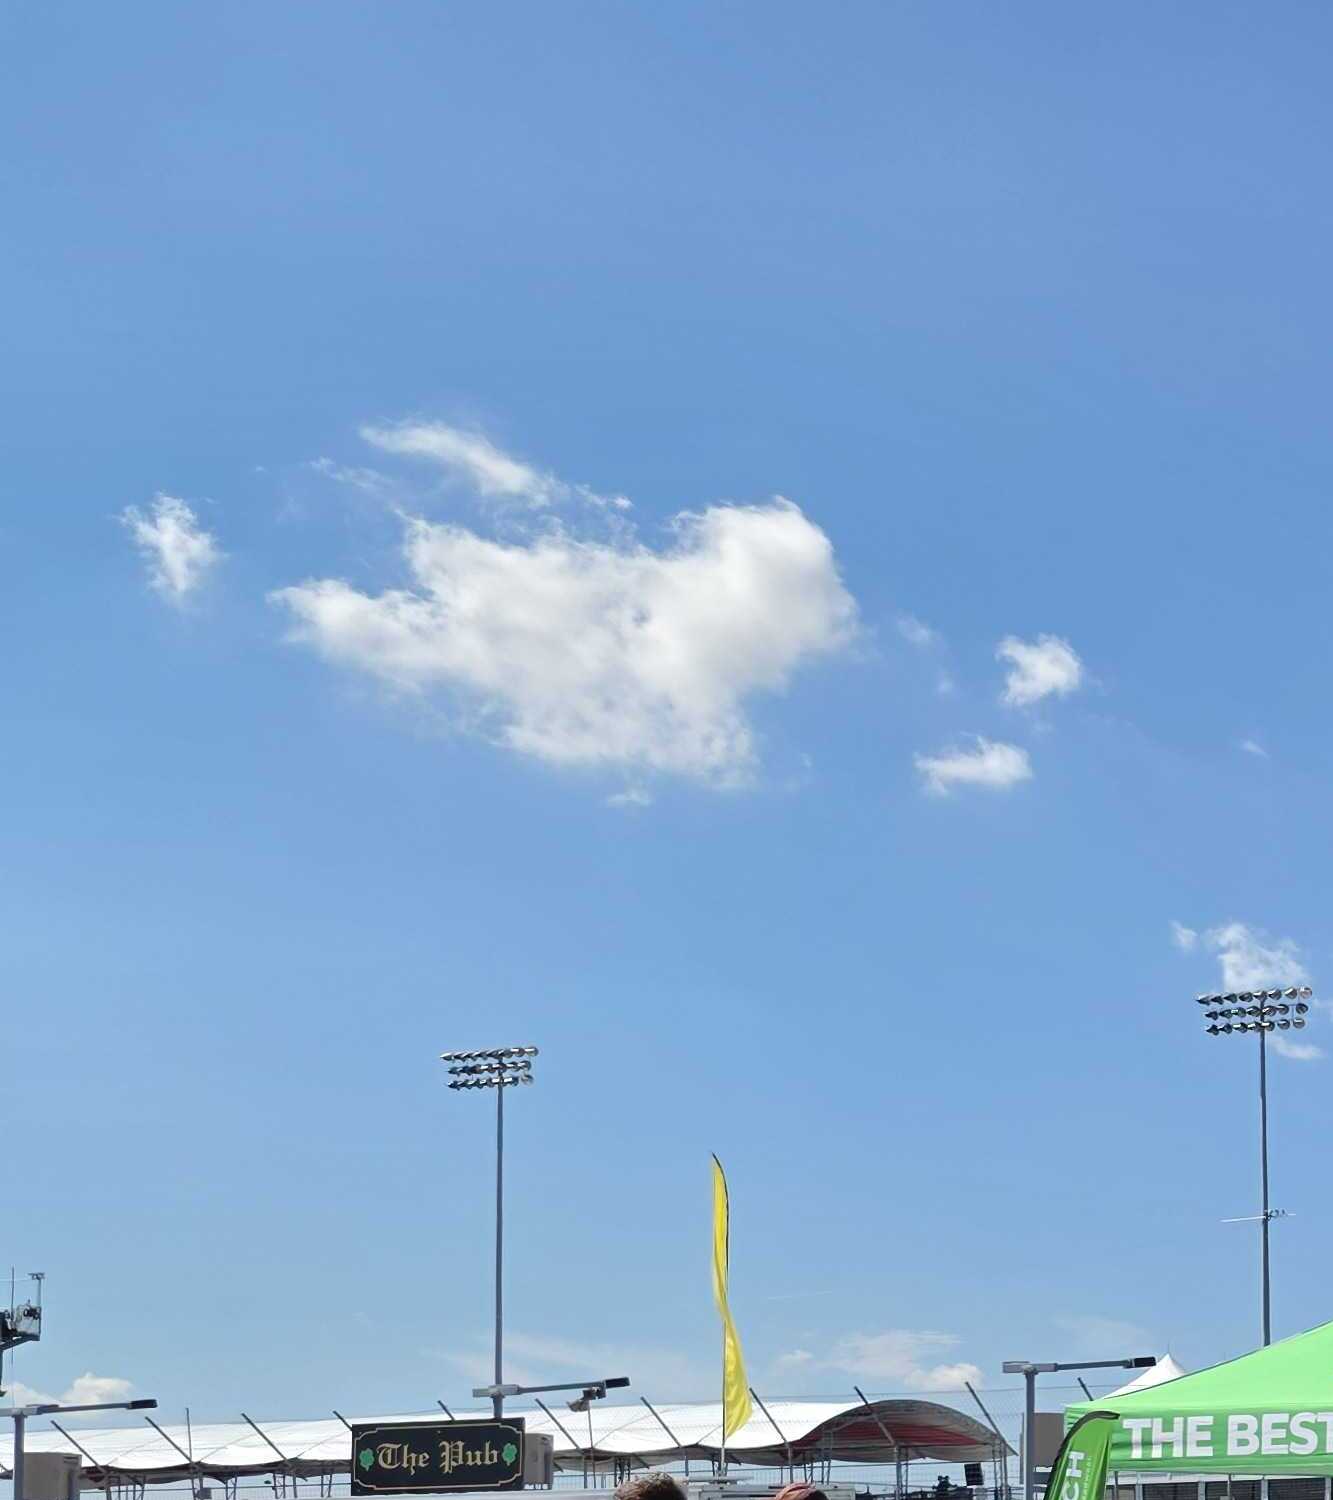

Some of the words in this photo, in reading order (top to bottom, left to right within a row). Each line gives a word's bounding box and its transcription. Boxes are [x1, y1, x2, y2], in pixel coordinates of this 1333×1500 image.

[1122, 1415, 1215, 1460] THE
[376, 1443, 430, 1476] The
[439, 1440, 498, 1474] Pub
